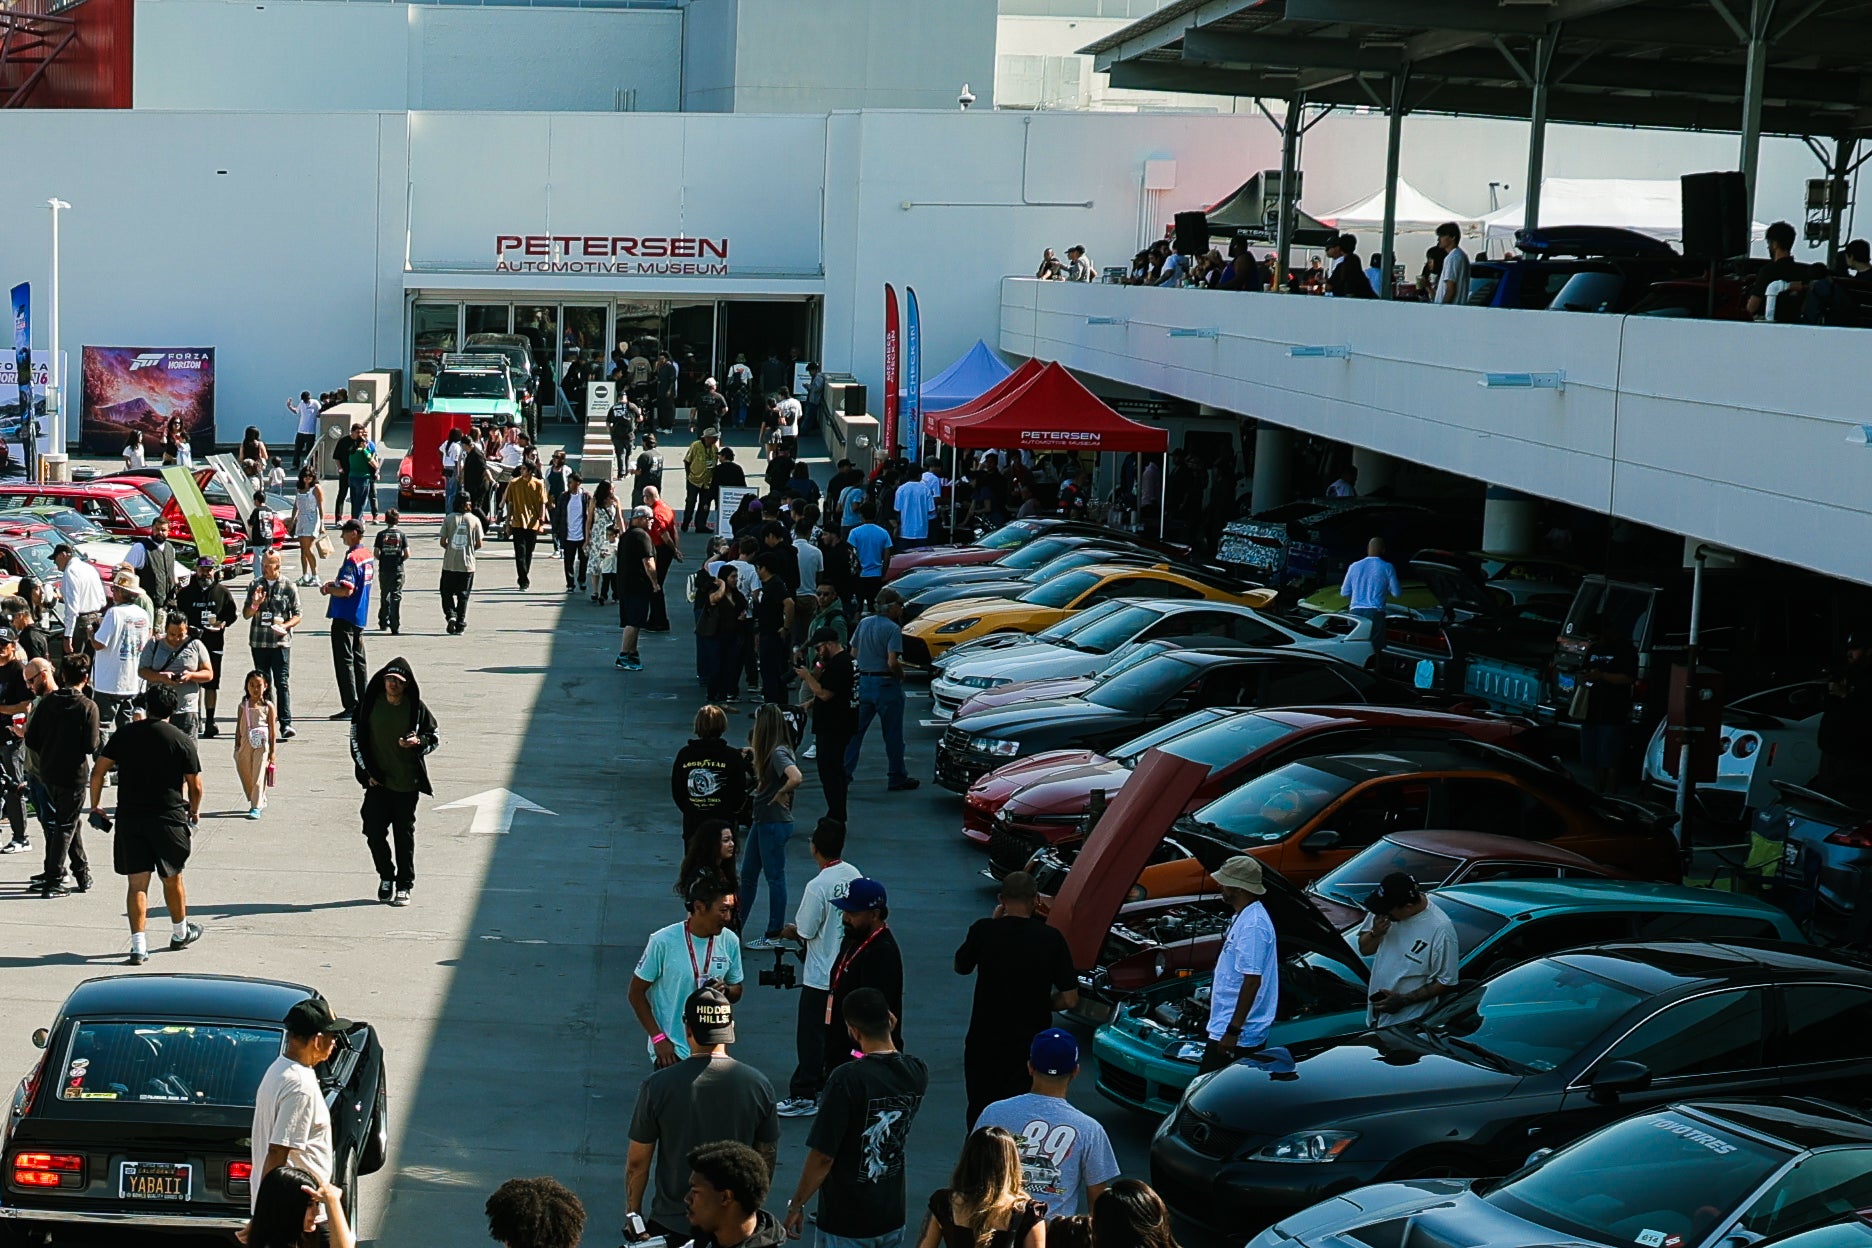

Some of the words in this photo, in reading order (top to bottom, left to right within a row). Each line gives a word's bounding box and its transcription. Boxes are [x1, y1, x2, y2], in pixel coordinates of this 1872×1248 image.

[1236, 228, 1278, 236] PETERS
[496, 235, 728, 259] PETERSEN
[495, 261, 629, 274] AUTOMOTIVE
[636, 262, 728, 275] MUSEUM
[168, 352, 209, 360] FORZA
[167, 360, 202, 369] HORIZON
[39, 372, 49, 385] 6
[1020, 431, 1101, 441] PETERSEN
[1475, 670, 1529, 701] TOYOTA
[699, 1014, 730, 1024] HILLS
[1020, 1119, 1077, 1168] 89
[129, 1175, 182, 1195] YABAII
